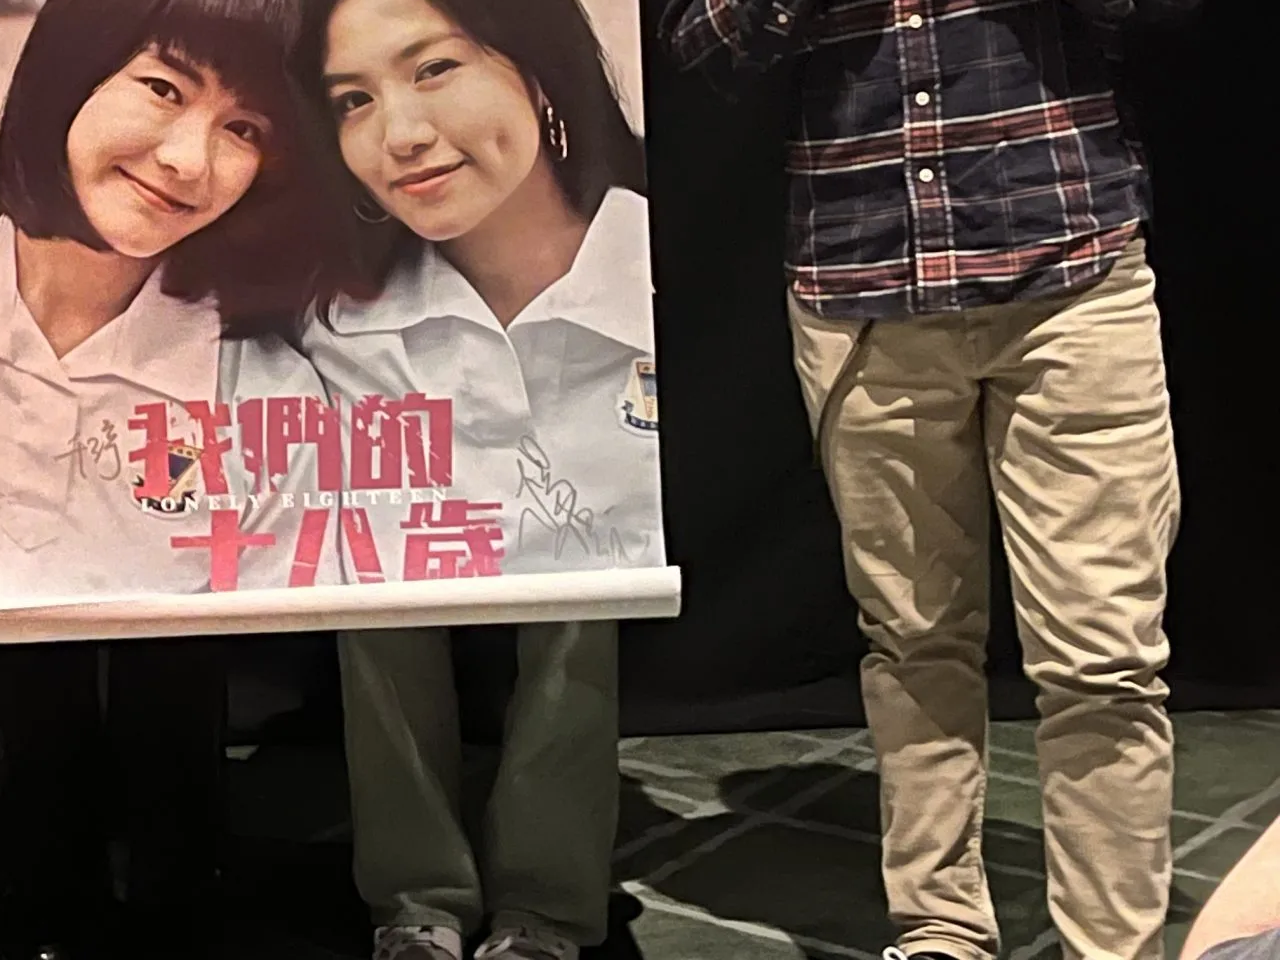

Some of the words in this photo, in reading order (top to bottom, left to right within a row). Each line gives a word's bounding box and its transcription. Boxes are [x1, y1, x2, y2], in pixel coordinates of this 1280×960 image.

[127, 393, 454, 498] 我們的
[141, 494, 260, 513] LONELY
[282, 488, 449, 509] EIGHTEEN
